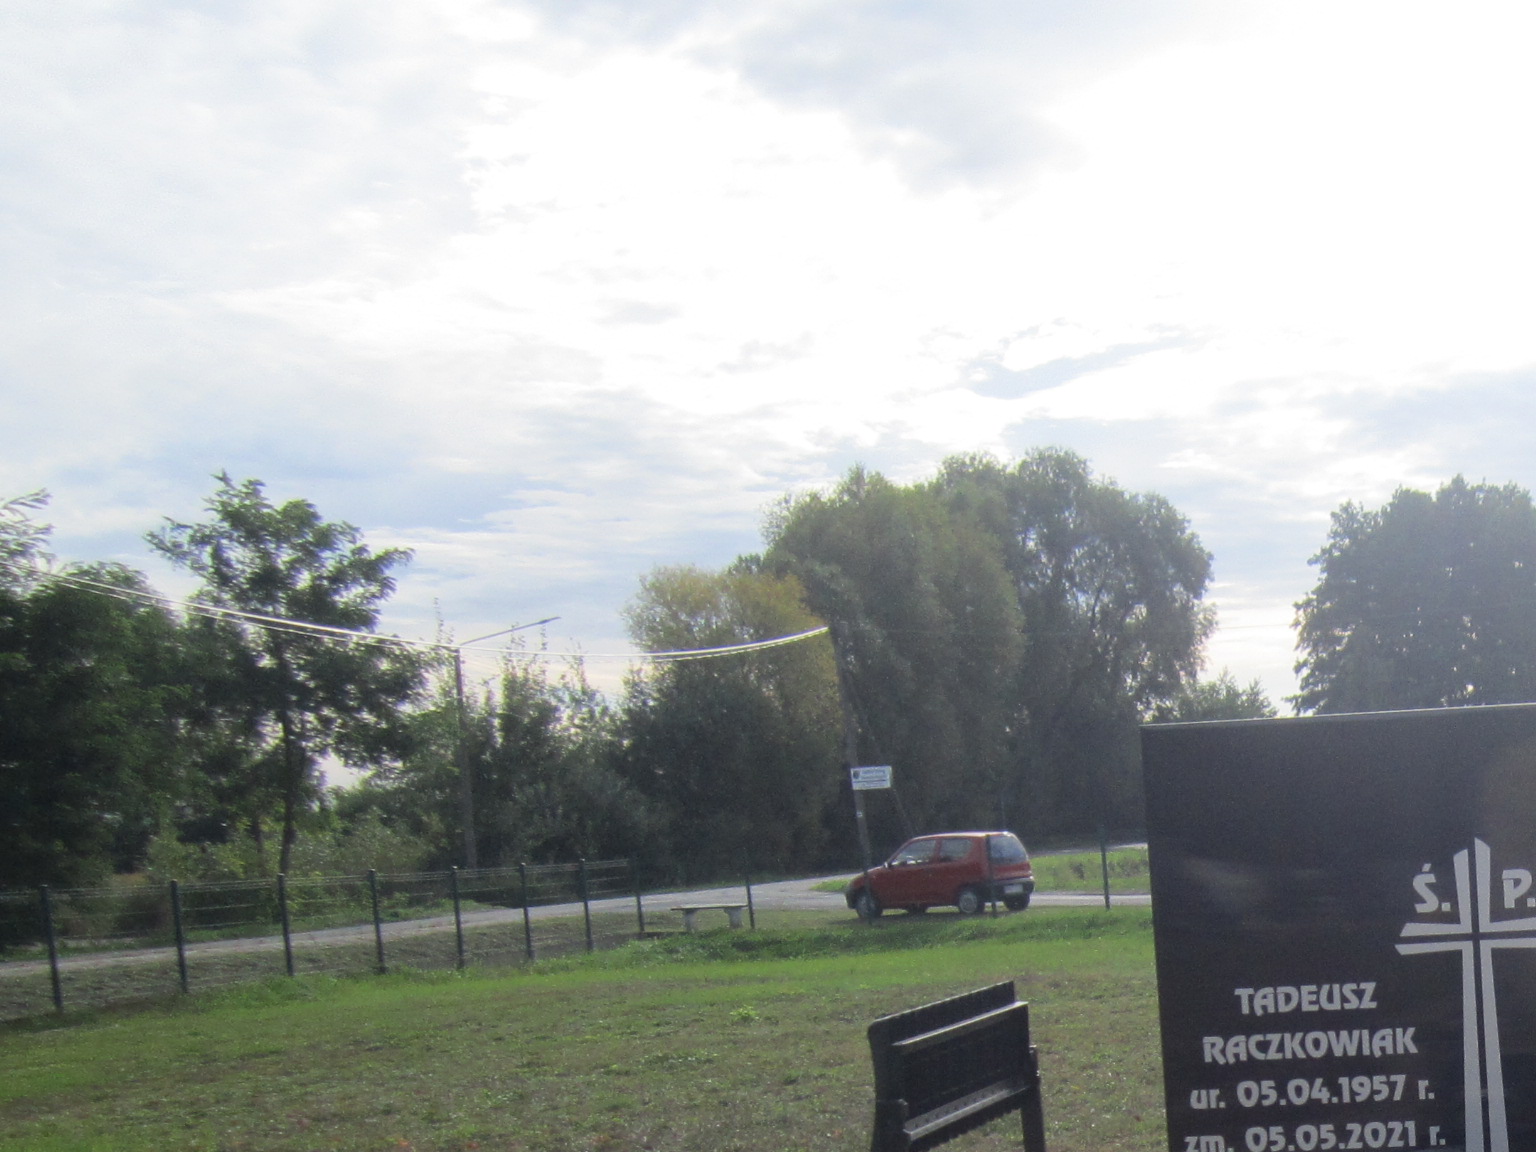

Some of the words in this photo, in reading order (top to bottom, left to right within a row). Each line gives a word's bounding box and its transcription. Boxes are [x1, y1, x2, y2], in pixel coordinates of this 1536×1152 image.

[1501, 868, 1536, 909] P.
[1234, 981, 1378, 1017] TADEUSZ
[1202, 1027, 1419, 1065] RACZKOWIAK
[1189, 1088, 1226, 1110] ur.
[1236, 1074, 1407, 1108] 05.04.1957
[1417, 1079, 1436, 1101] r.
[1429, 1125, 1447, 1147] r.
